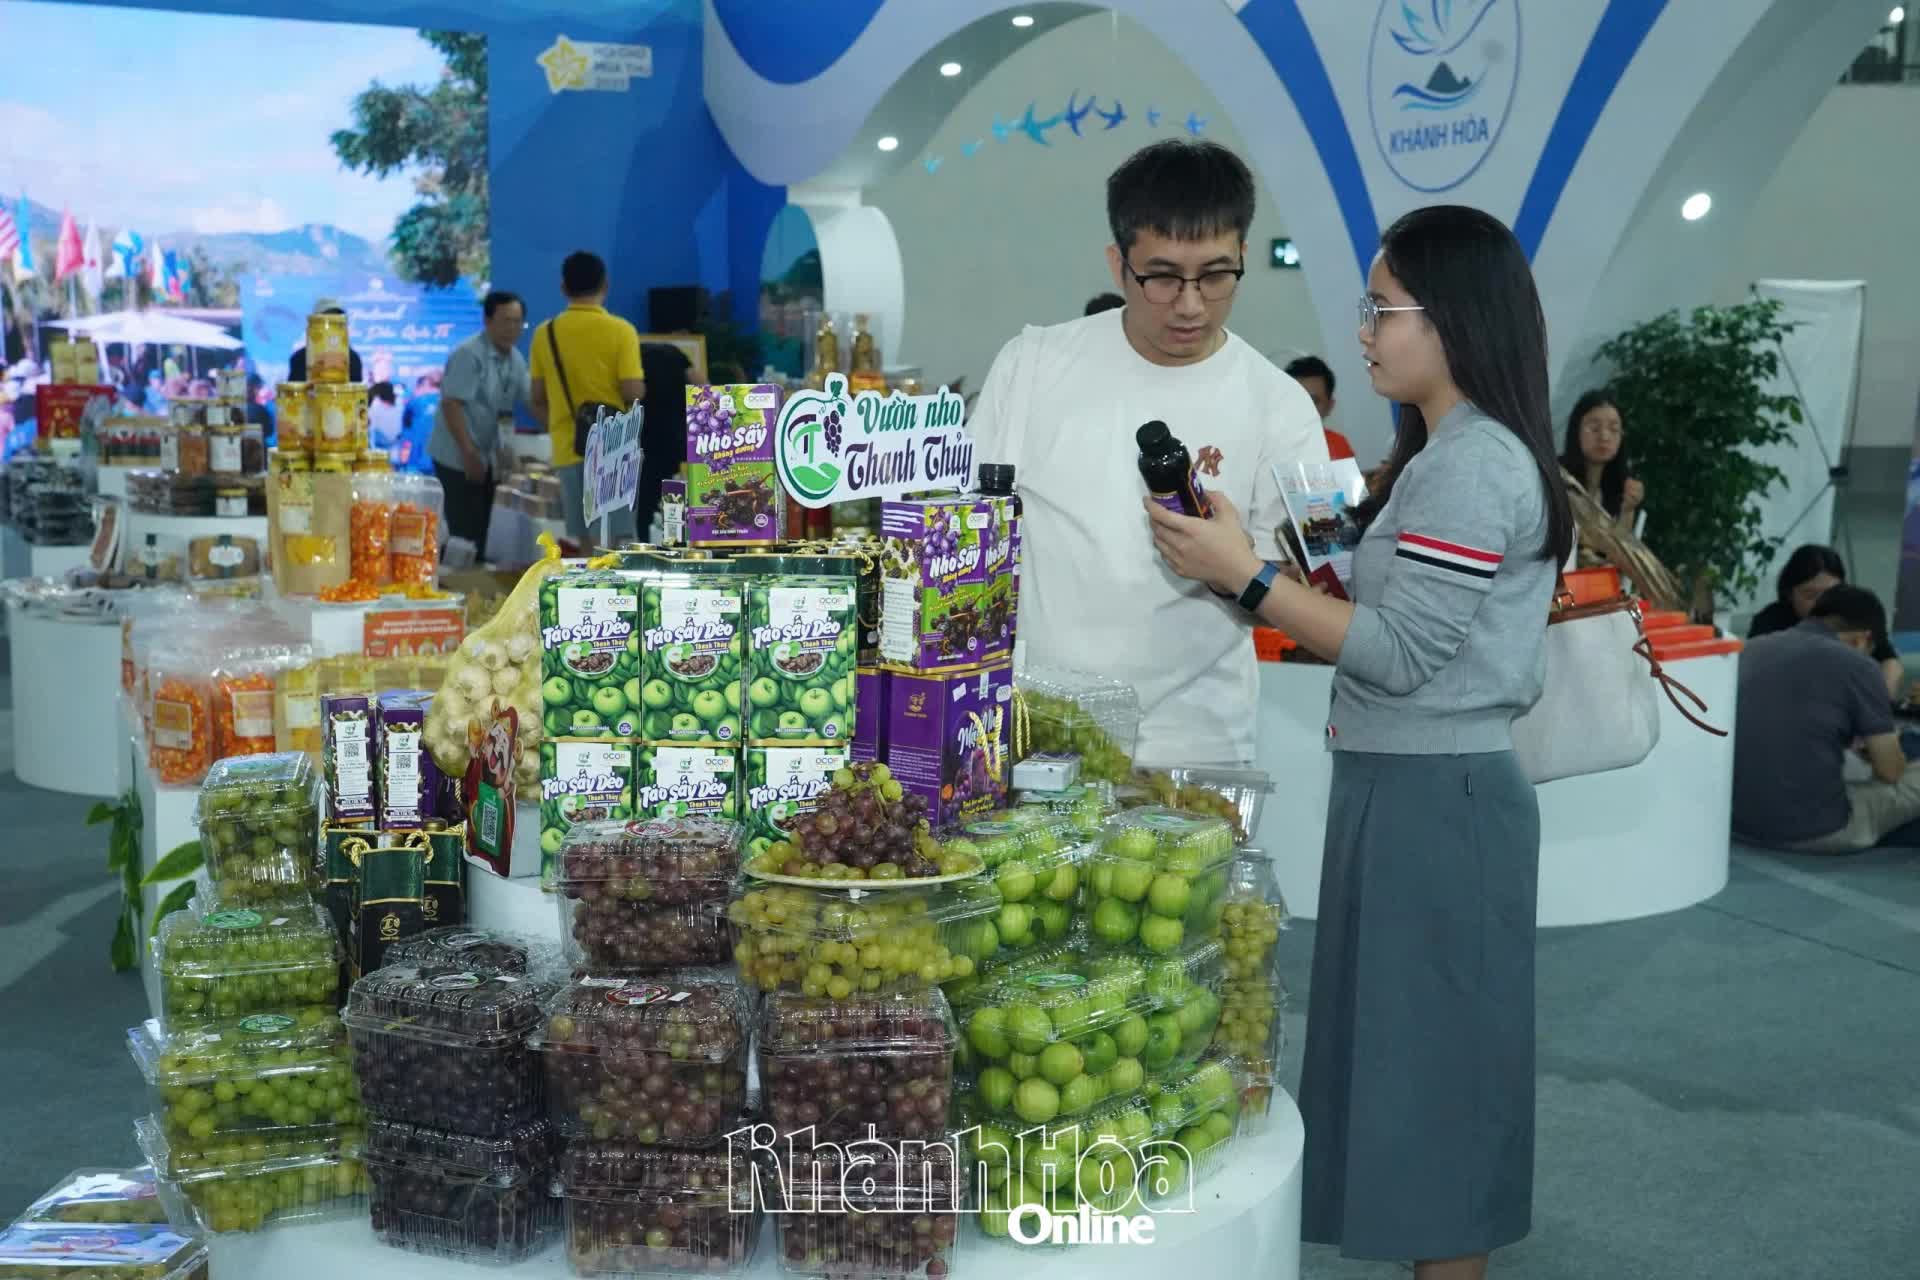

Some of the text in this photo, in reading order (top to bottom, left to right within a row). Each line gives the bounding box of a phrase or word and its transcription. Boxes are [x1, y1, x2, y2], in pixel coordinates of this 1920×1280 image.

[1391, 113, 1488, 154] KHÁNH HÒA
[857, 392, 961, 434] Vườn nho
[695, 423, 767, 455] Nho Sấy
[845, 432, 973, 491] Thanh Thủy
[929, 554, 956, 578] Nho
[958, 544, 981, 570] Sấy
[542, 615, 631, 649] Táo Sấy Dẻo
[645, 617, 734, 651] Táo Sấy Dẻo
[752, 615, 841, 649] Táo Sấy Dẻo
[541, 769, 625, 800] Táo Sấy Dẻo
[640, 775, 727, 809] Táo Sấy Dẻo
[750, 785, 778, 809] Táo
[779, 775, 808, 803] Sấy
